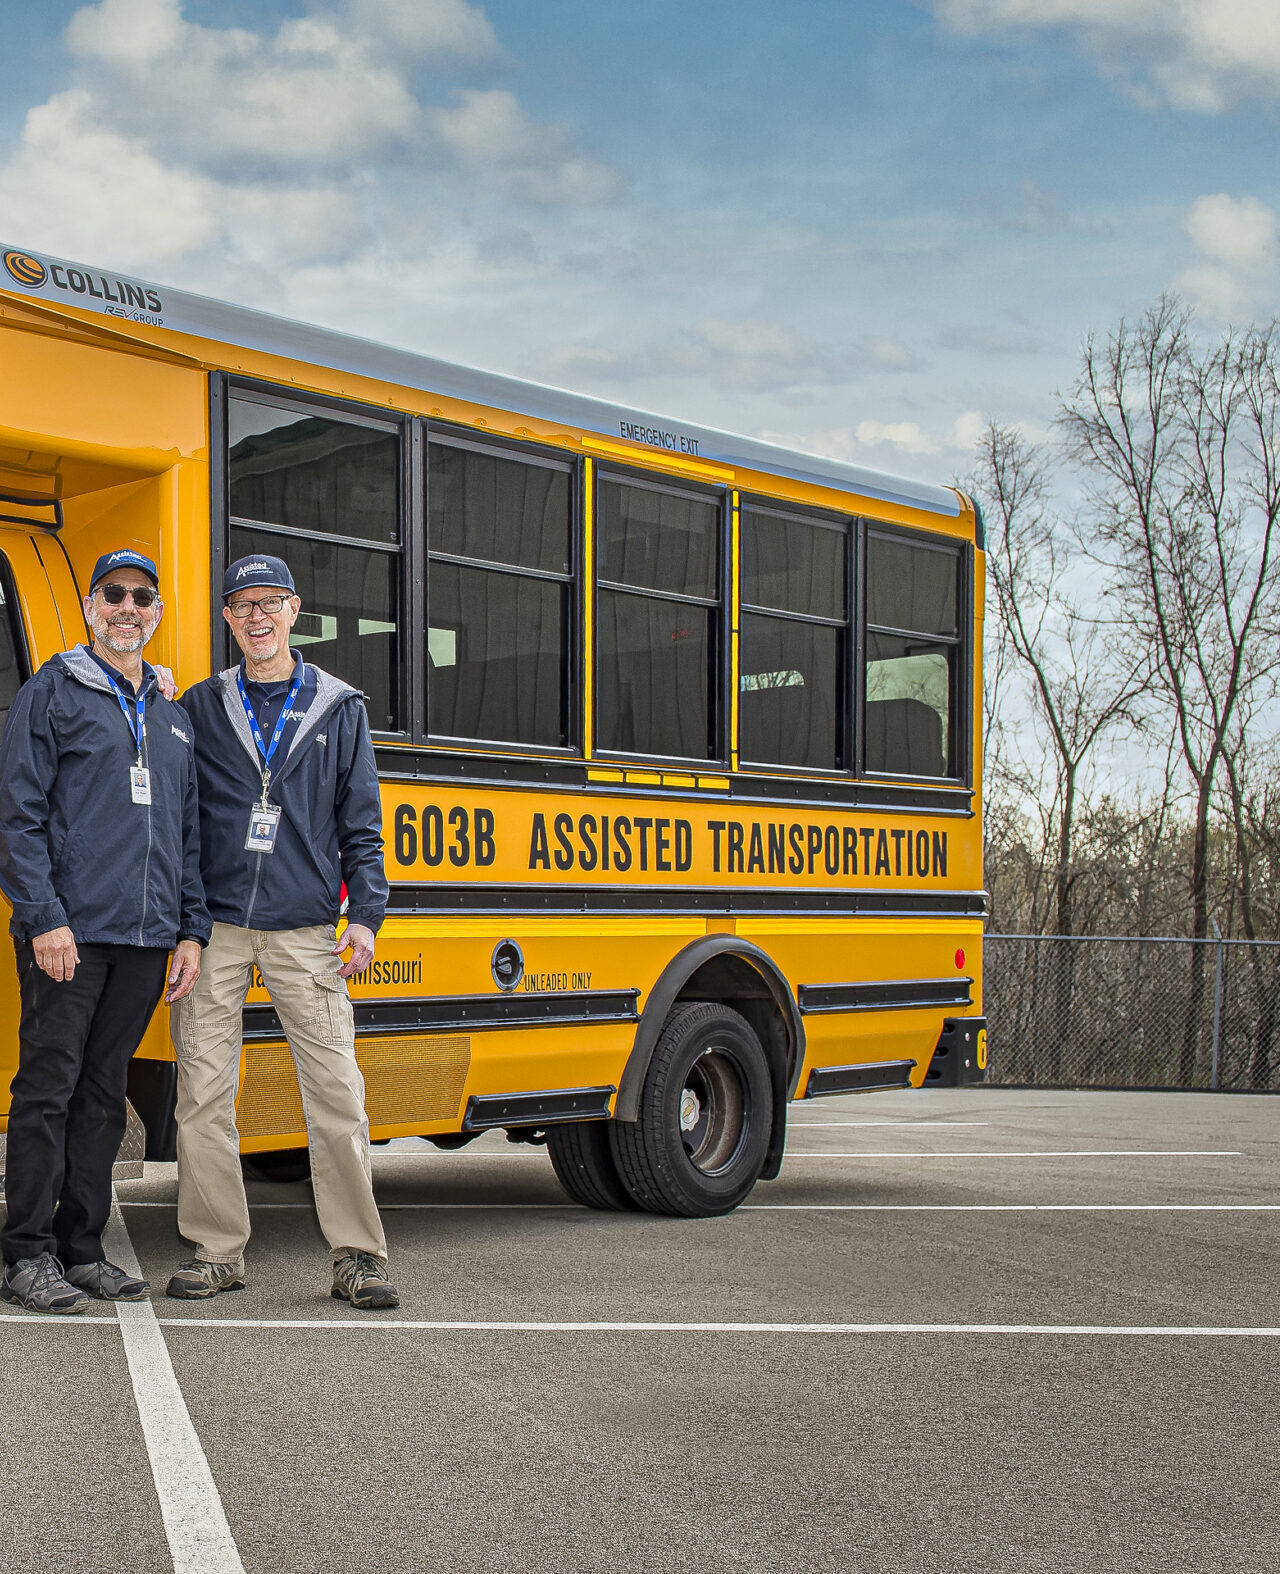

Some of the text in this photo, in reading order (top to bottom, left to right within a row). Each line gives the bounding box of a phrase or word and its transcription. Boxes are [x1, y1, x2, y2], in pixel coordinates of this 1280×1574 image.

[49, 264, 162, 313] COLLINS
[133, 312, 164, 327] GROUP
[620, 421, 700, 456] EMERGENCY EXIT
[394, 803, 948, 878] 603B ASSISTED TRANSPORTATION
[524, 972, 592, 992] UNLEADED ONLY
